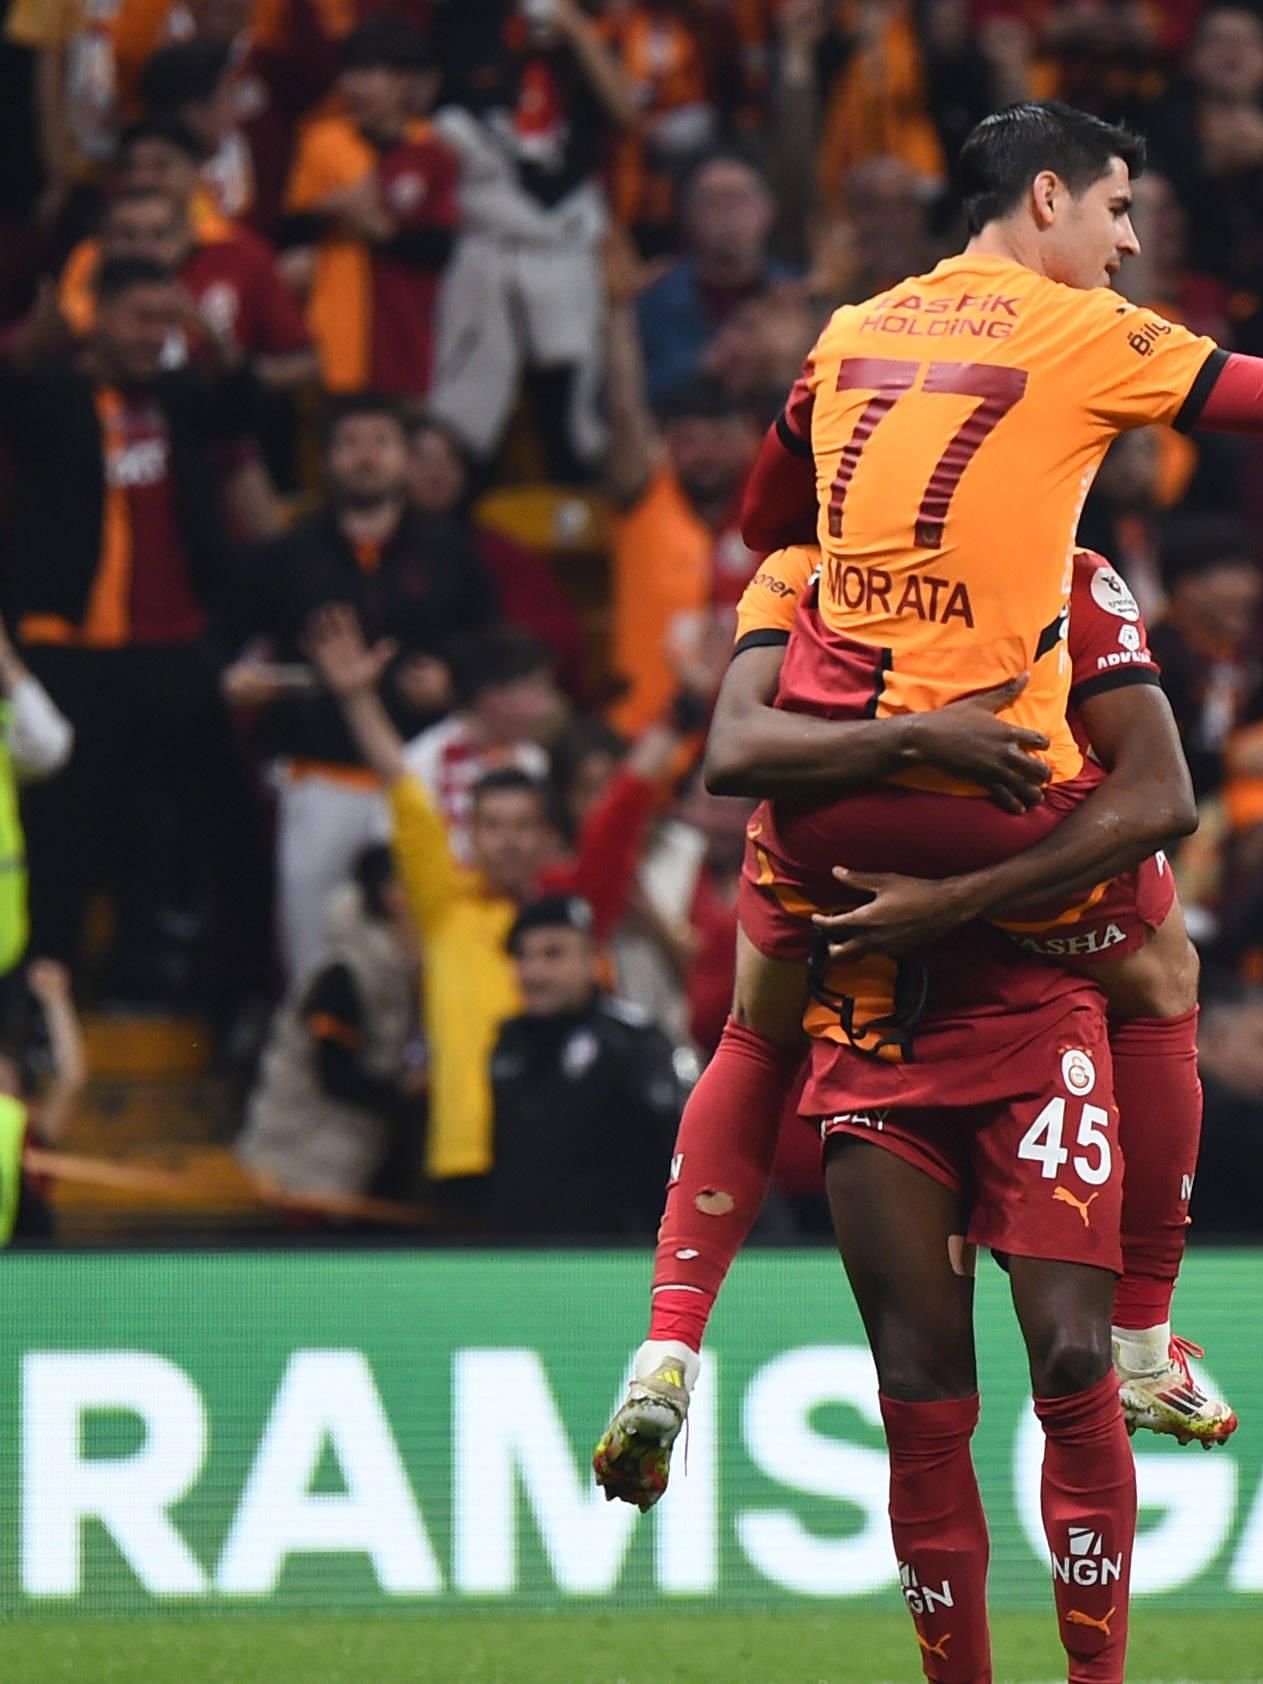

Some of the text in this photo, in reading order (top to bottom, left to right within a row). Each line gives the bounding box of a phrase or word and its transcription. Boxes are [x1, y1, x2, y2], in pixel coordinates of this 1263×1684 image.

[828, 357, 1028, 550] 77
[827, 556, 975, 629] MORATA
[1009, 923, 1127, 956] ASHA
[1018, 1096, 1112, 1186] 45
[18, 1345, 897, 1598] RAMS
[901, 1580, 954, 1614] GN
[1052, 1552, 1122, 1587] NGN
